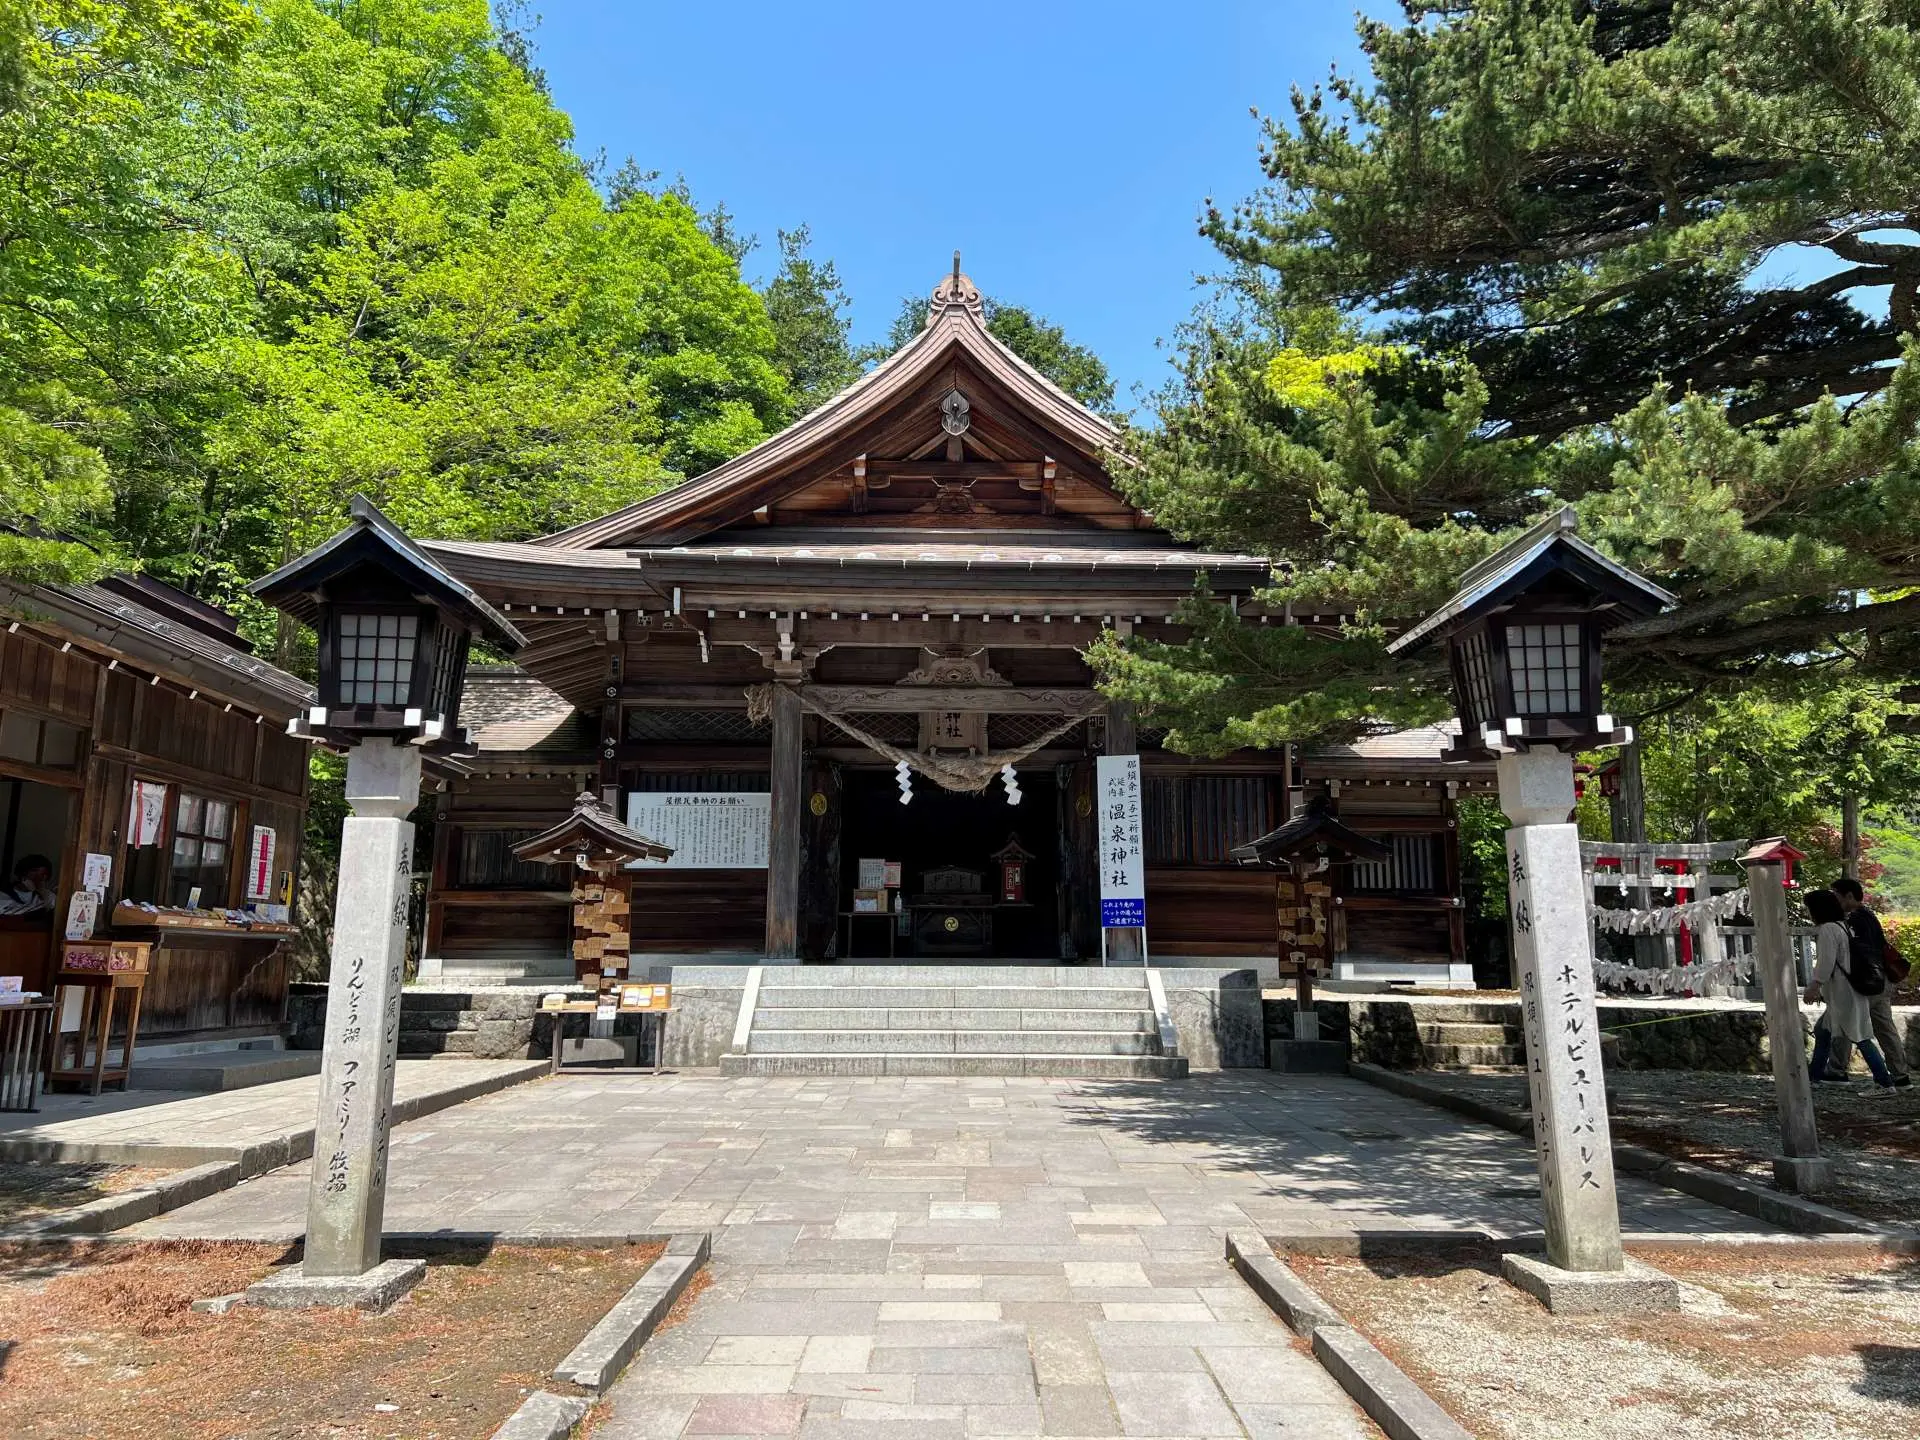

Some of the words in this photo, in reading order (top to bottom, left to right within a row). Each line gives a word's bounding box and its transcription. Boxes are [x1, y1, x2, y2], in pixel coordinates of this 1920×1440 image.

[1109, 803, 1129, 888] 温泉神社
[1512, 849, 1531, 934] 奉納
